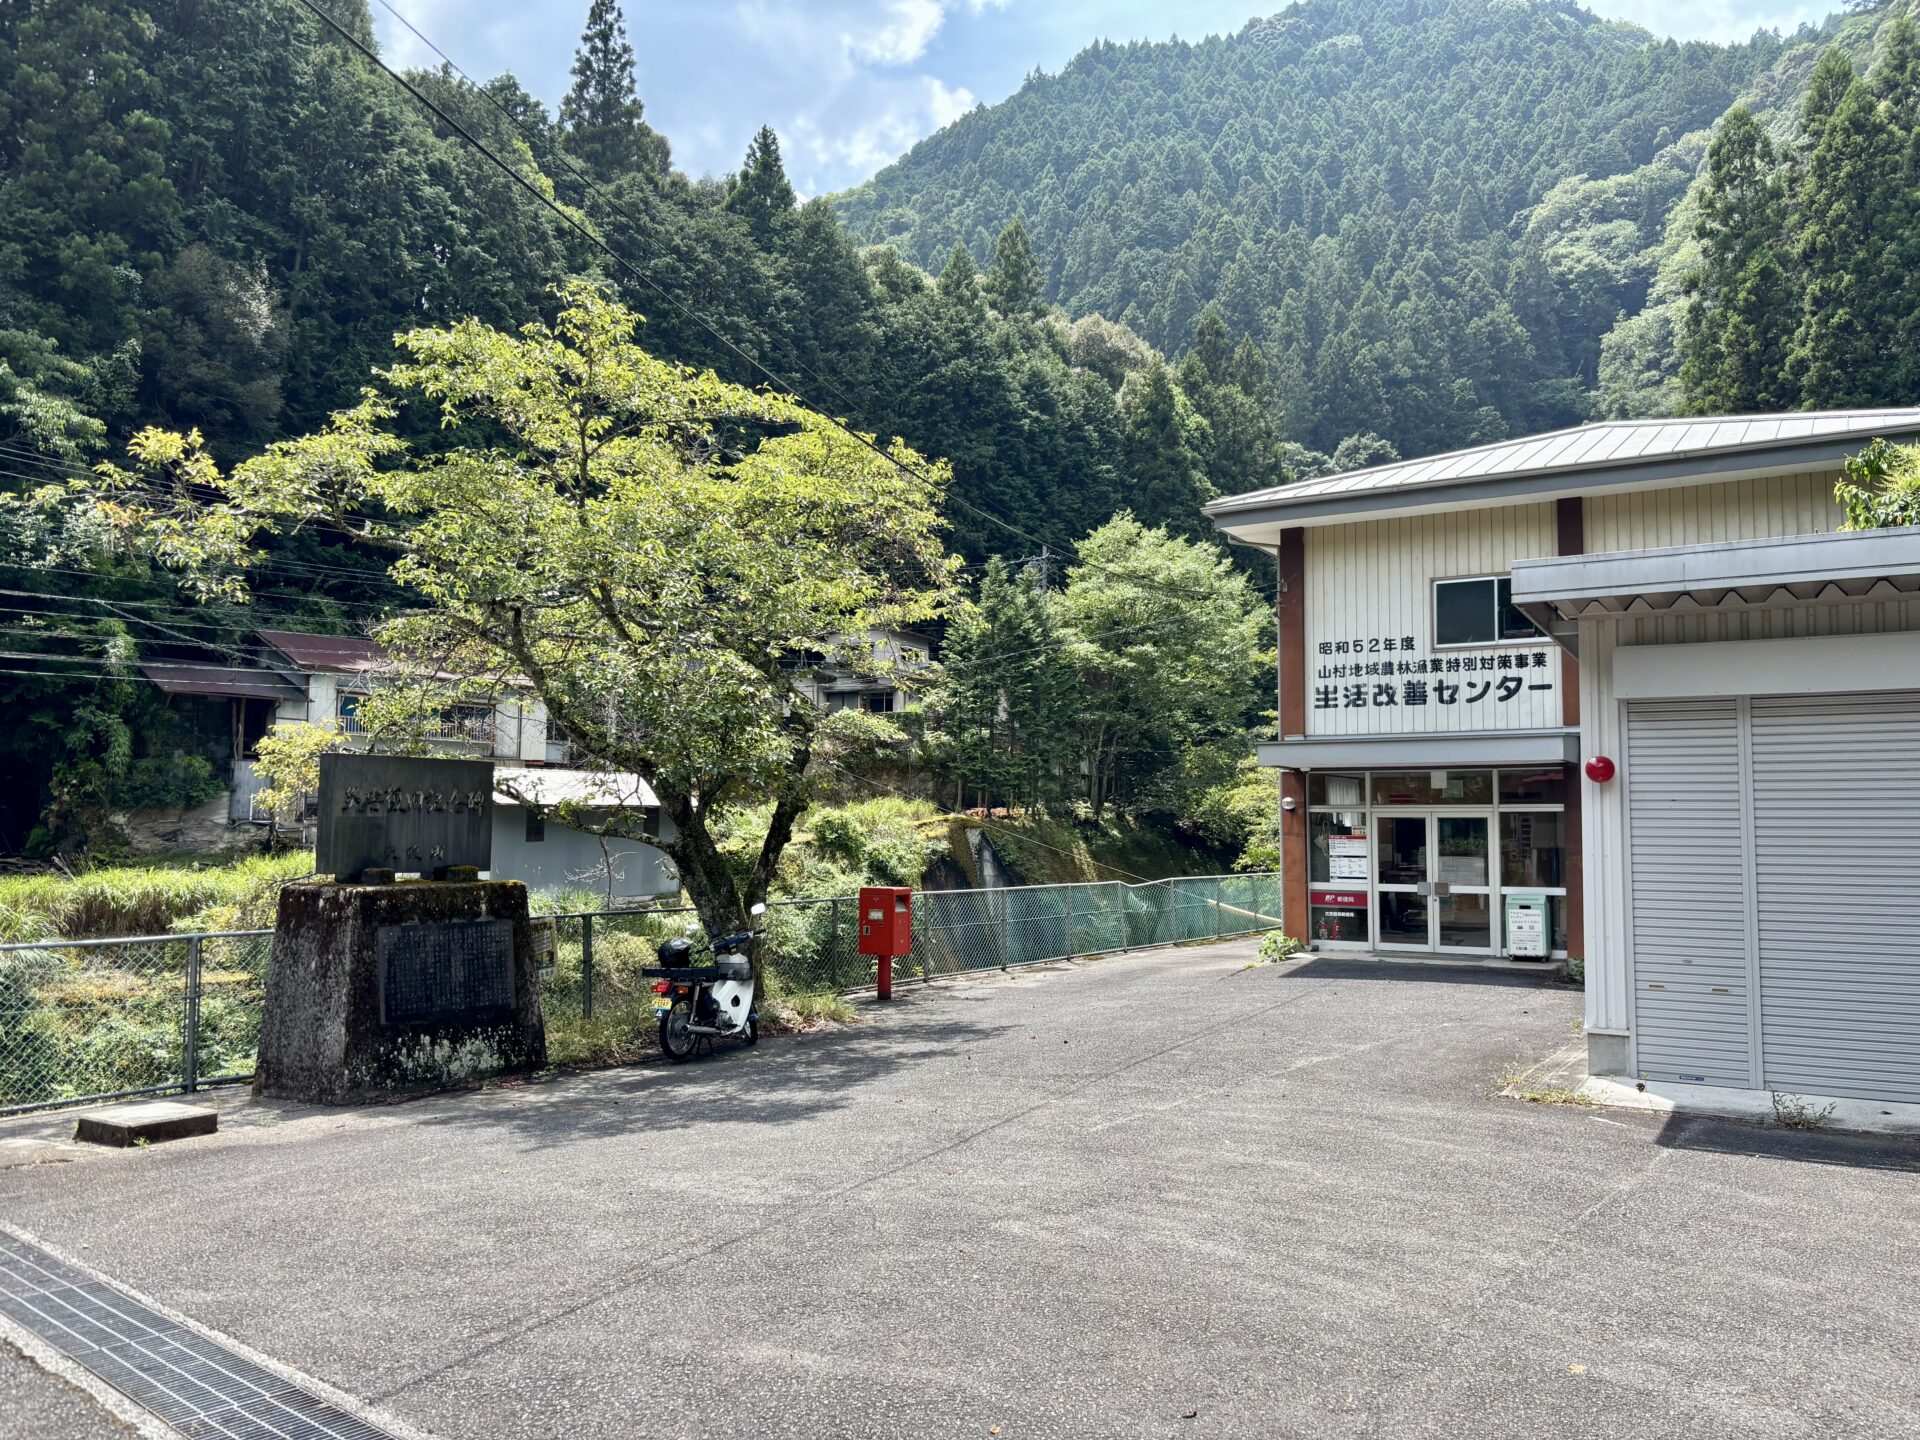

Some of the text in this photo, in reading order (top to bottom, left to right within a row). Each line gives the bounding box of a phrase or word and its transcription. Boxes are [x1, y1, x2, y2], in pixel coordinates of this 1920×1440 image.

[1318, 636, 1416, 655] 昭和52年度
[1318, 652, 1548, 679] 山村地域農林漁業特別対策事業
[1314, 675, 1553, 709] 生活改善センター
